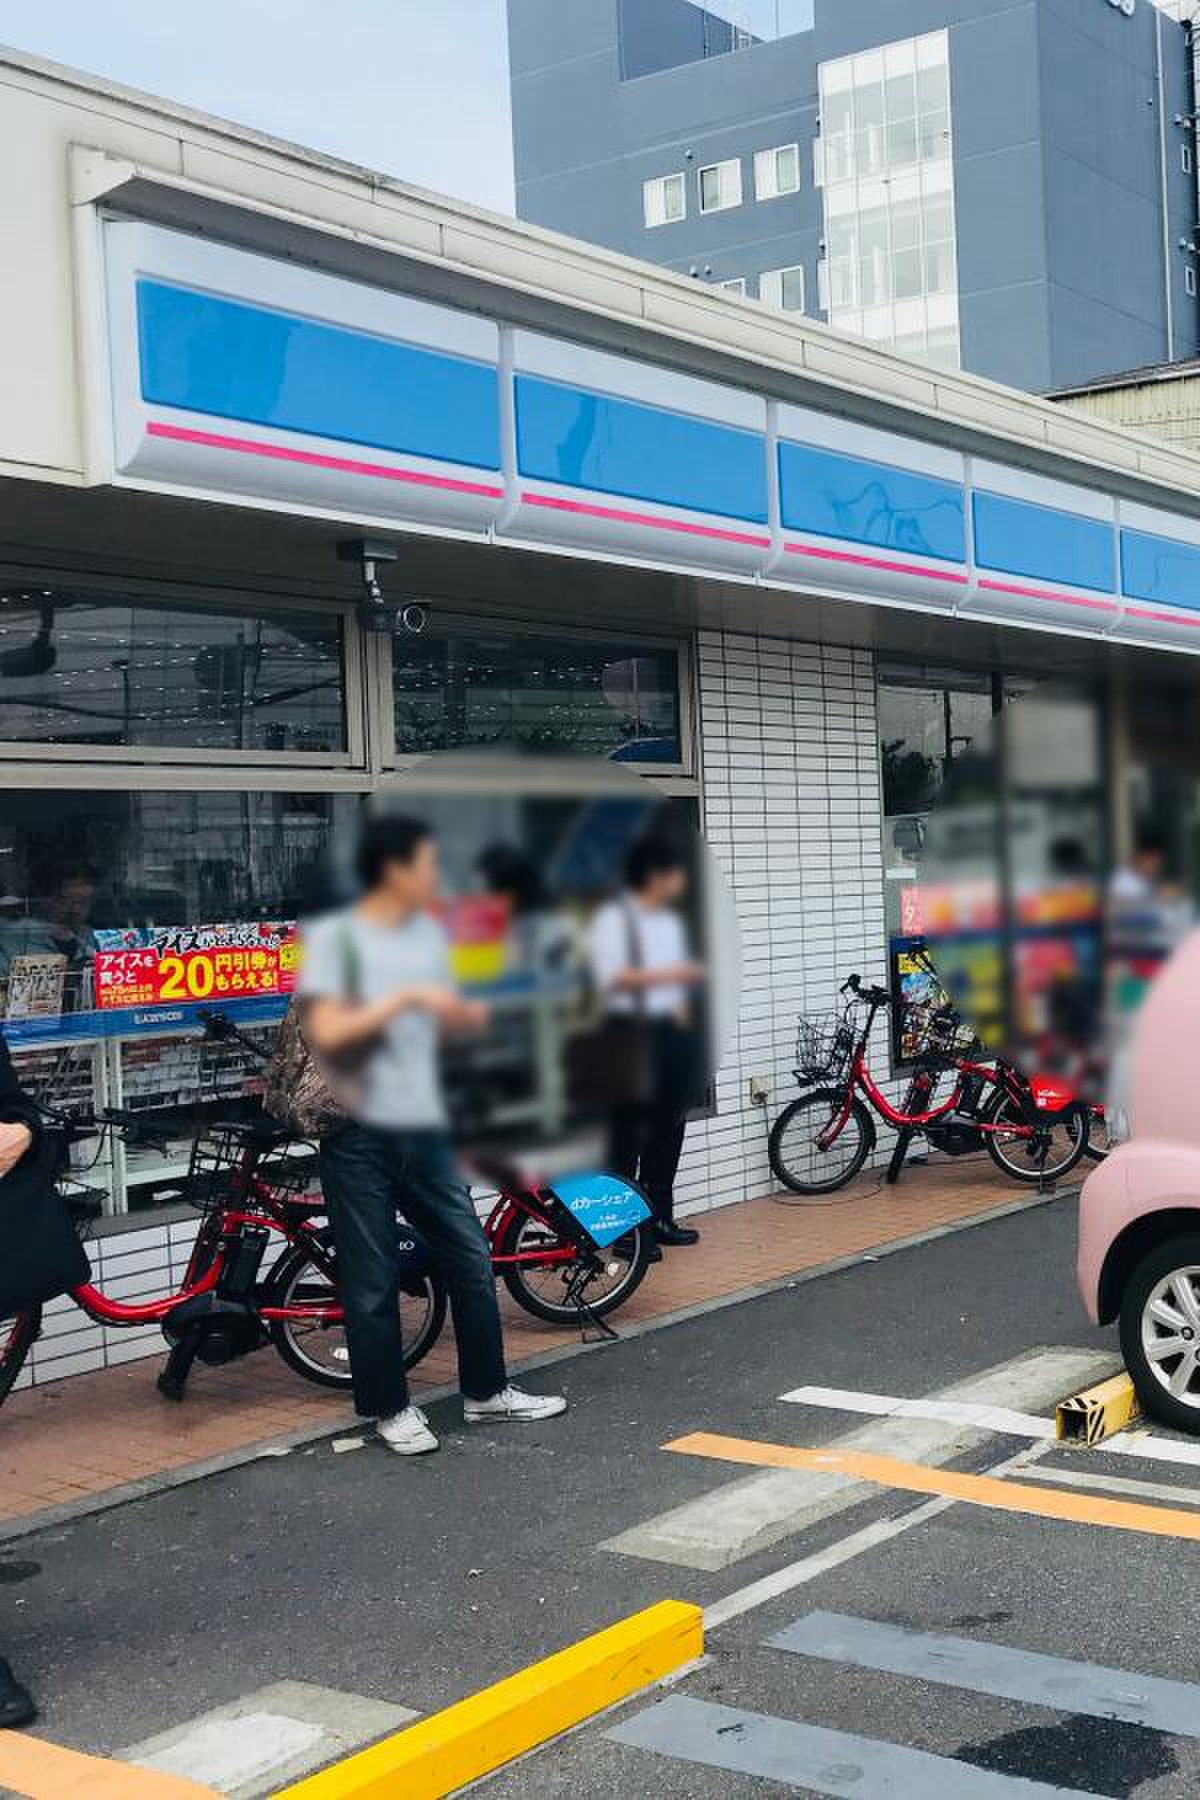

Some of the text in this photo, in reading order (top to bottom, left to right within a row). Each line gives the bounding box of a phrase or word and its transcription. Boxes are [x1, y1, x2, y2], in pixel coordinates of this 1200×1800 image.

[100, 953, 154, 969] アイスを
[100, 970, 137, 985] 買うと
[158, 956, 214, 999] 20
[134, 1011, 183, 1024] LAWSON
